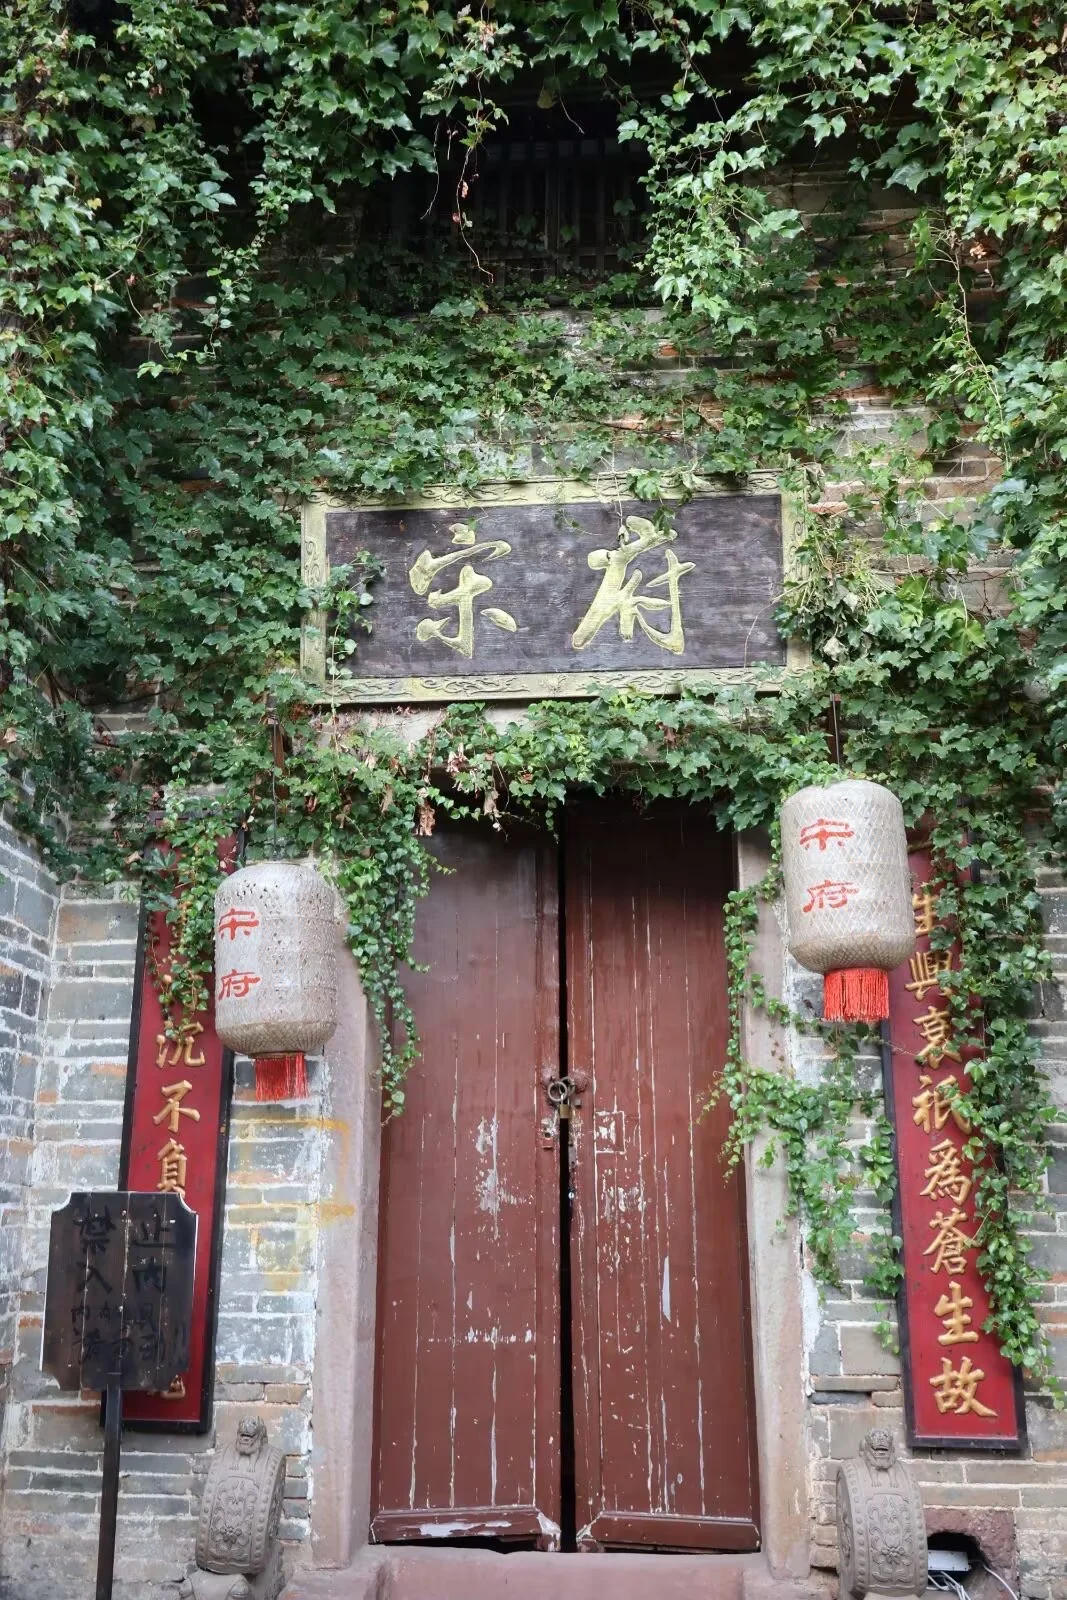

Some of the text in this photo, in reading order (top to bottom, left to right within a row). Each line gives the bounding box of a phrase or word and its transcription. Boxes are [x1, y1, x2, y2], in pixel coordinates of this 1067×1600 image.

[408, 514, 697, 659] 宋府
[800, 818, 860, 914] 宋府
[218, 907, 262, 1001] 宋府
